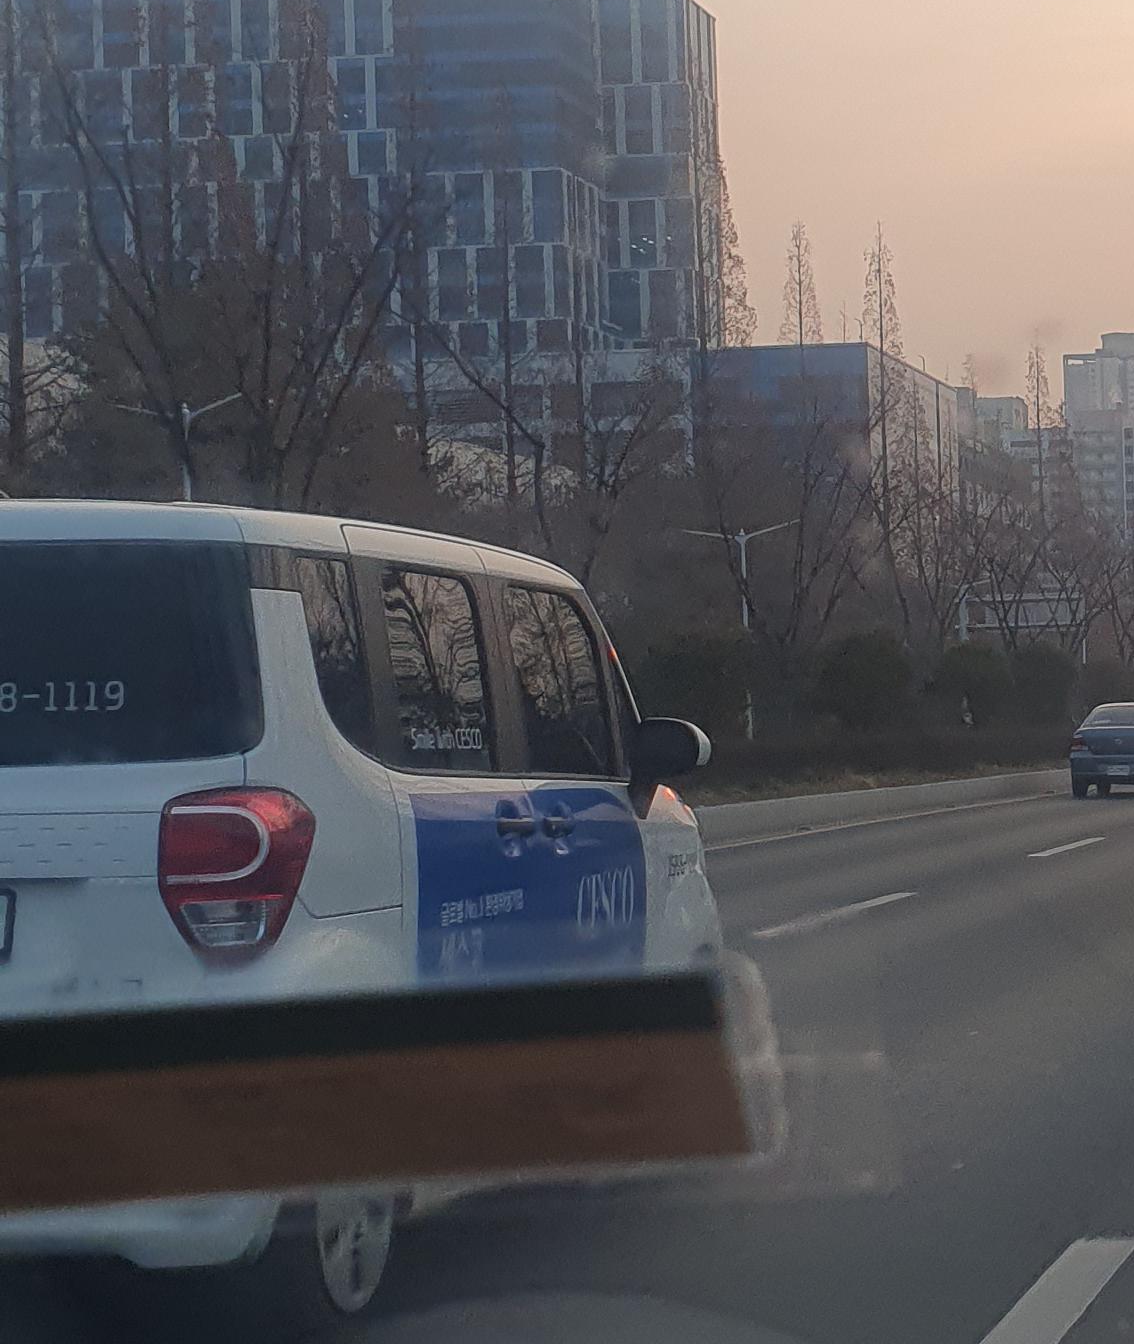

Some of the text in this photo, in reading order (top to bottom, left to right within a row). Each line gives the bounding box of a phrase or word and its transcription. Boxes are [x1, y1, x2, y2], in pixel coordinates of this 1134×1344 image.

[0, 681, 125, 713] 8-1119
[456, 727, 482, 750] CESCO
[577, 864, 634, 929] CESCO
